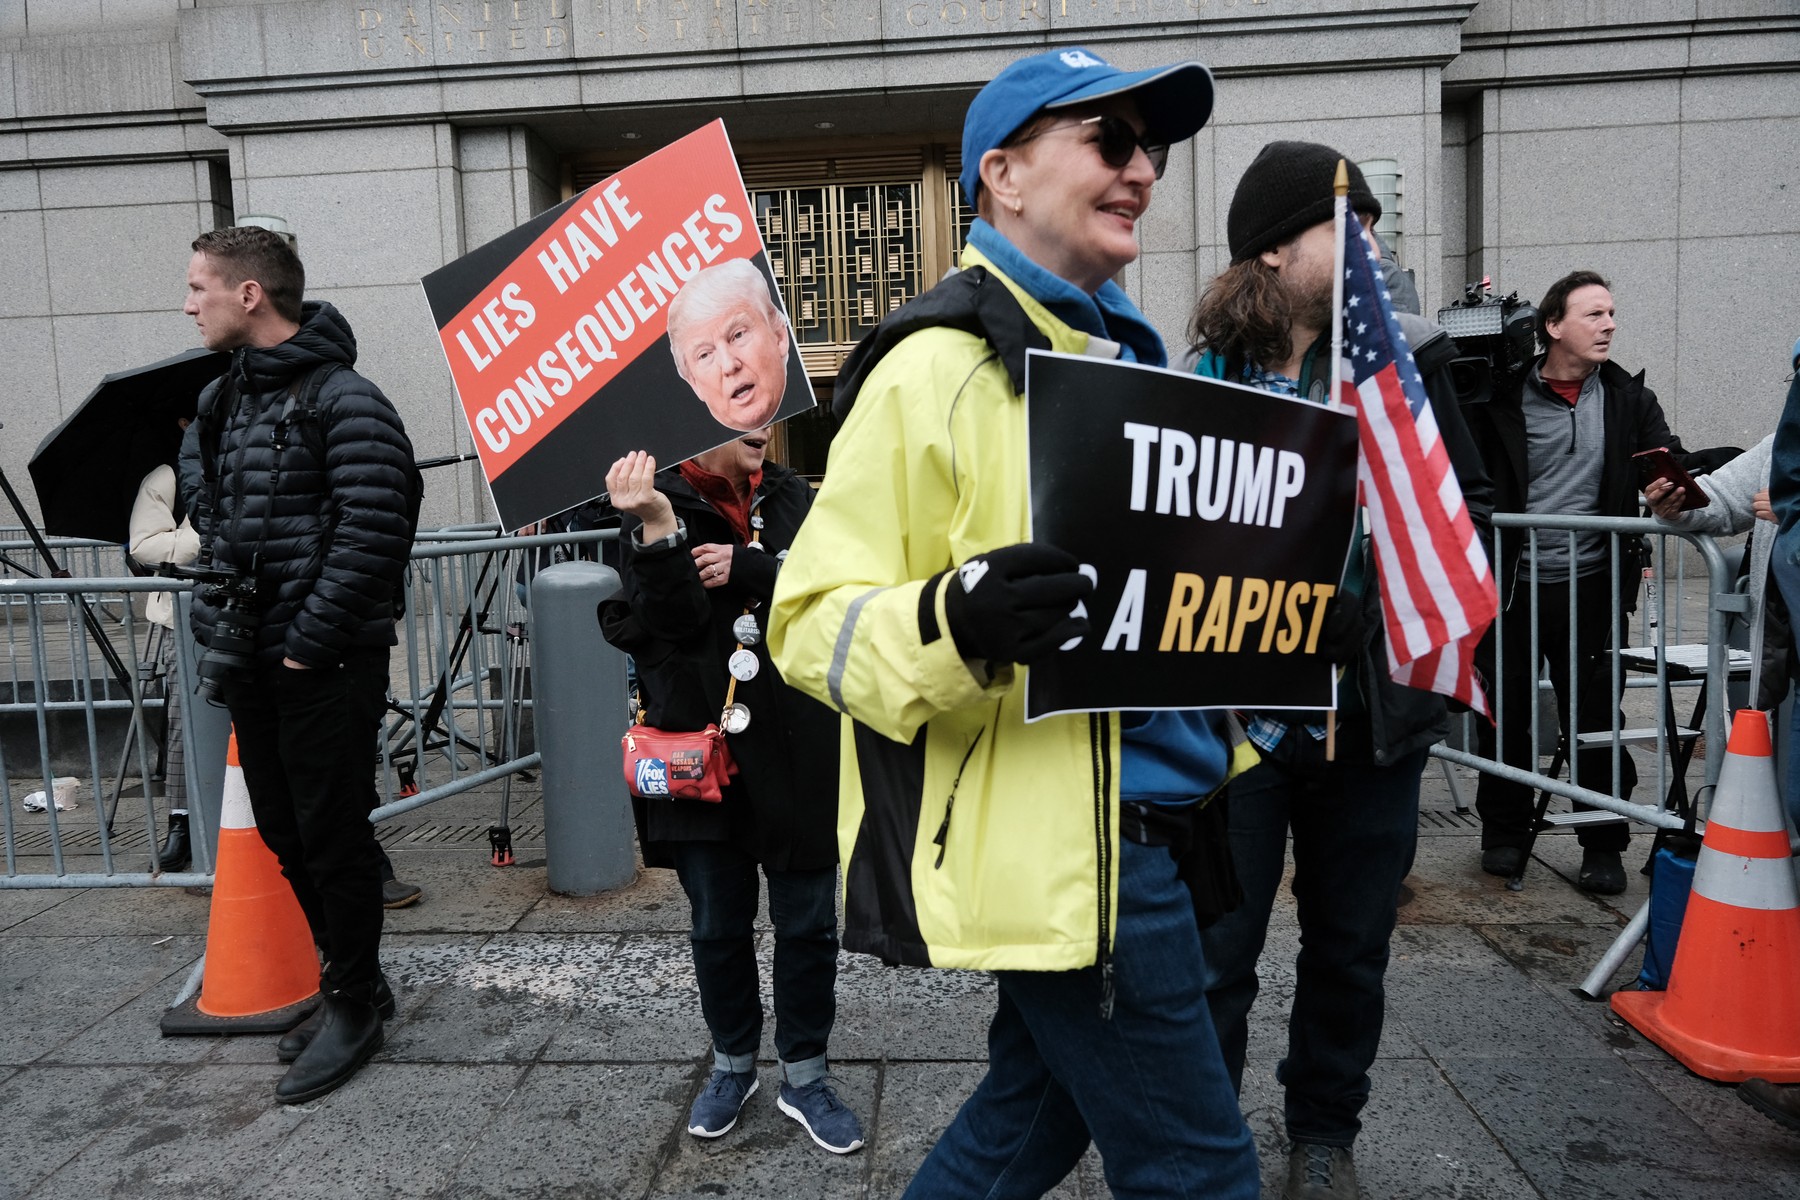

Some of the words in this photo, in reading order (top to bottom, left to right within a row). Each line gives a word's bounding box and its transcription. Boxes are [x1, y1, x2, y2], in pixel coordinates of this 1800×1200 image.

[359, 0, 568, 31] DANIEL
[361, 26, 569, 59] UNITED
[635, 10, 837, 43] STATES
[456, 282, 537, 373] LIES
[537, 178, 643, 295] HAVE
[475, 193, 743, 454] CONSEQUENCES
[1123, 421, 1306, 529] TRUMP
[1101, 568, 1148, 651] A
[1158, 572, 1336, 654] RAPIST
[641, 781, 668, 794] LIES
[646, 769, 664, 780] FOX
